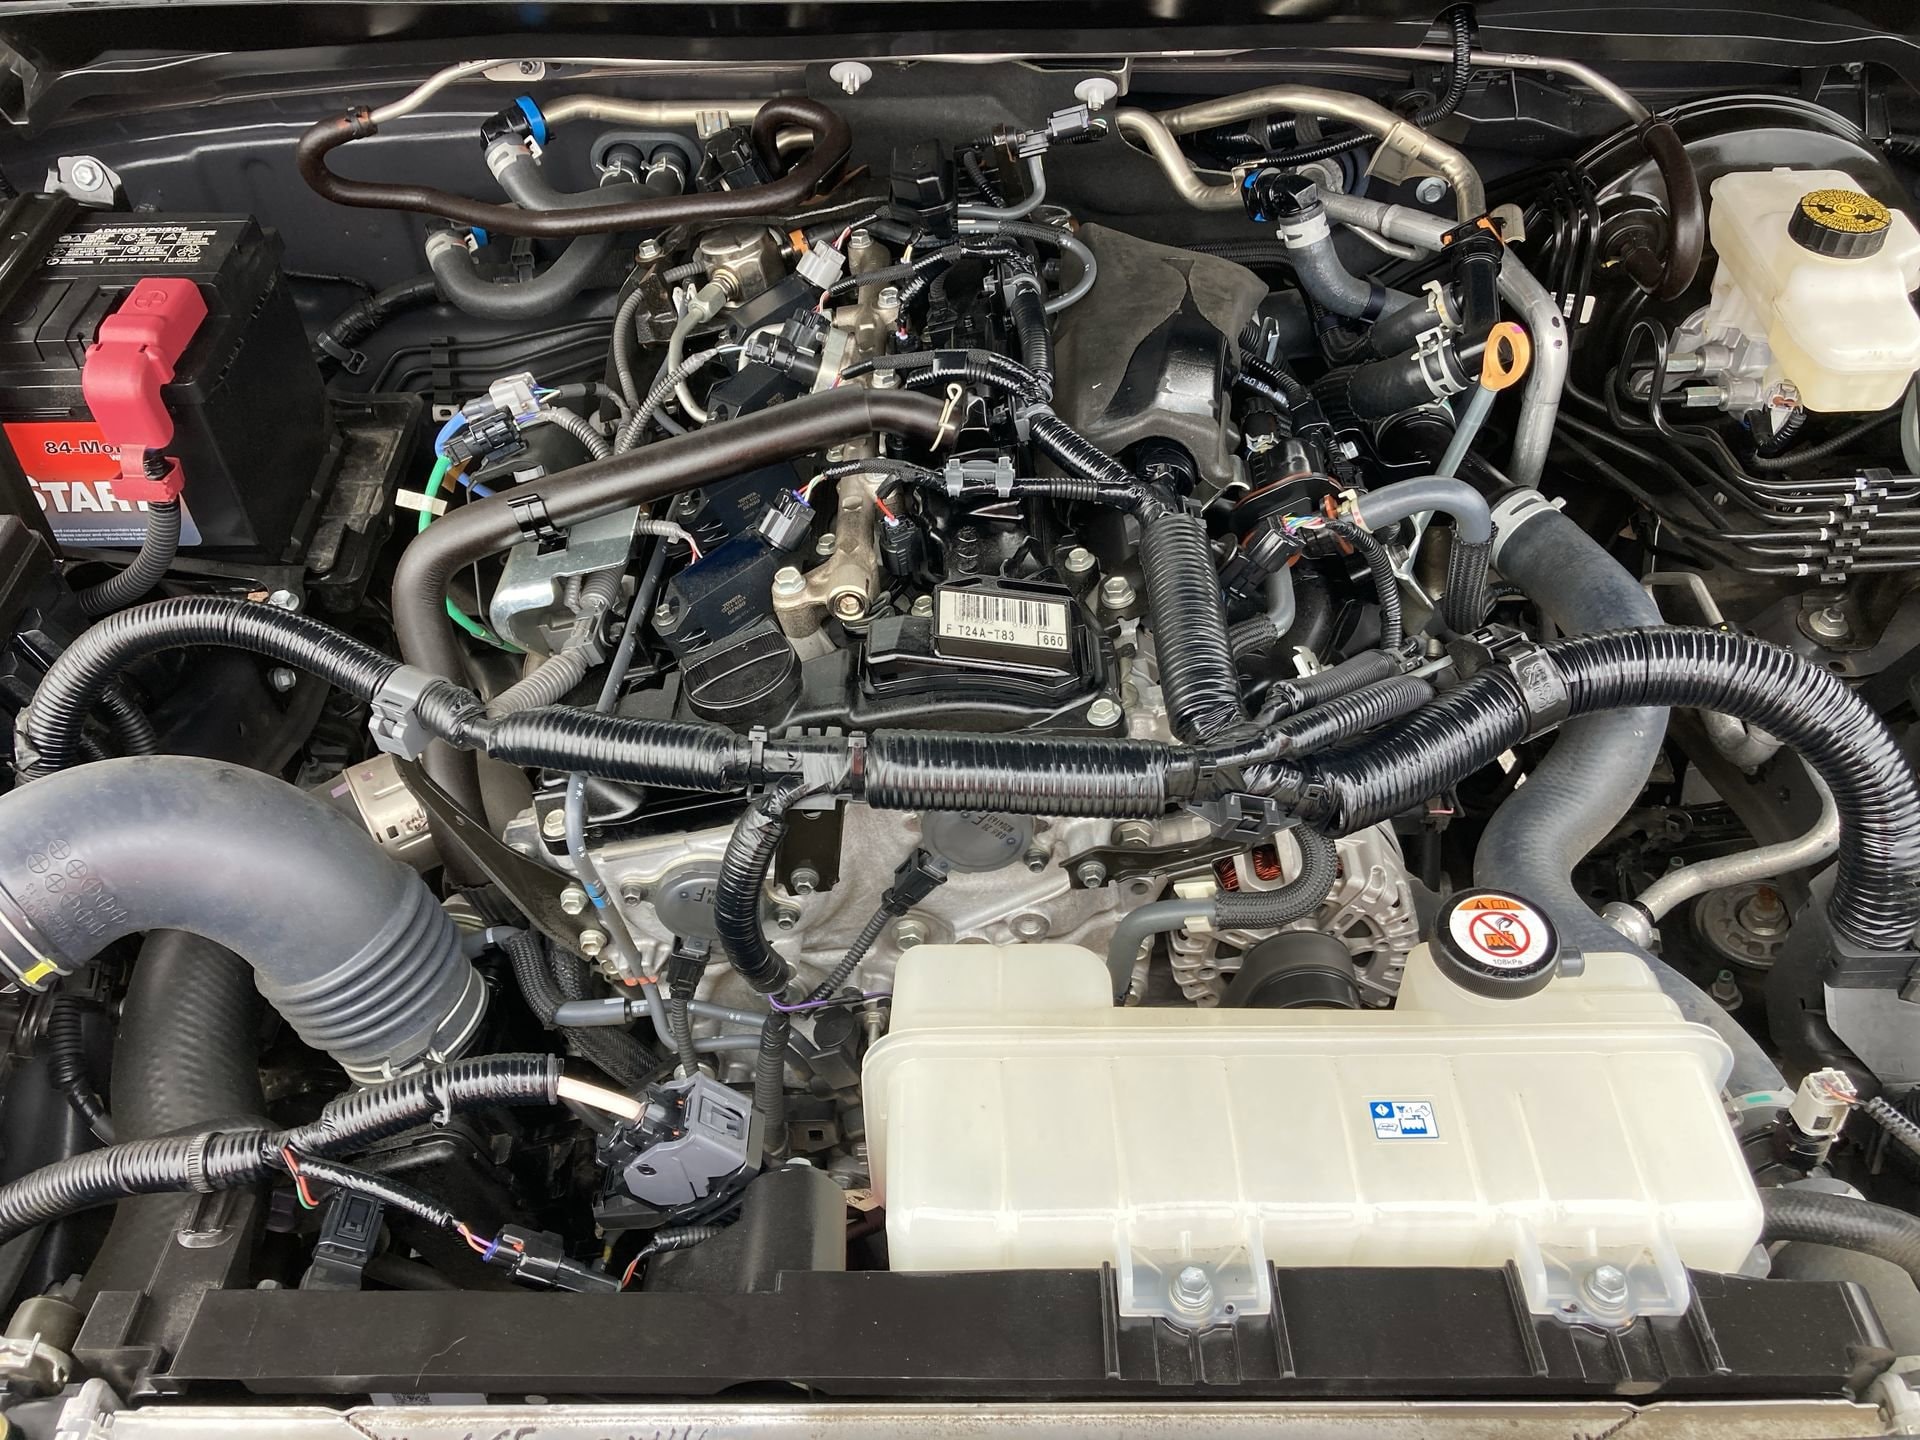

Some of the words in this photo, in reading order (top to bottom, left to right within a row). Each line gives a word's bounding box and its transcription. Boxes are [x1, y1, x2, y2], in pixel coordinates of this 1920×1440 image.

[27, 475, 149, 512] STAR
[946, 624, 953, 634] F
[958, 625, 1015, 641] T24A-T83
[1043, 634, 1064, 647] 660
[1492, 958, 1523, 966] 108kPa
